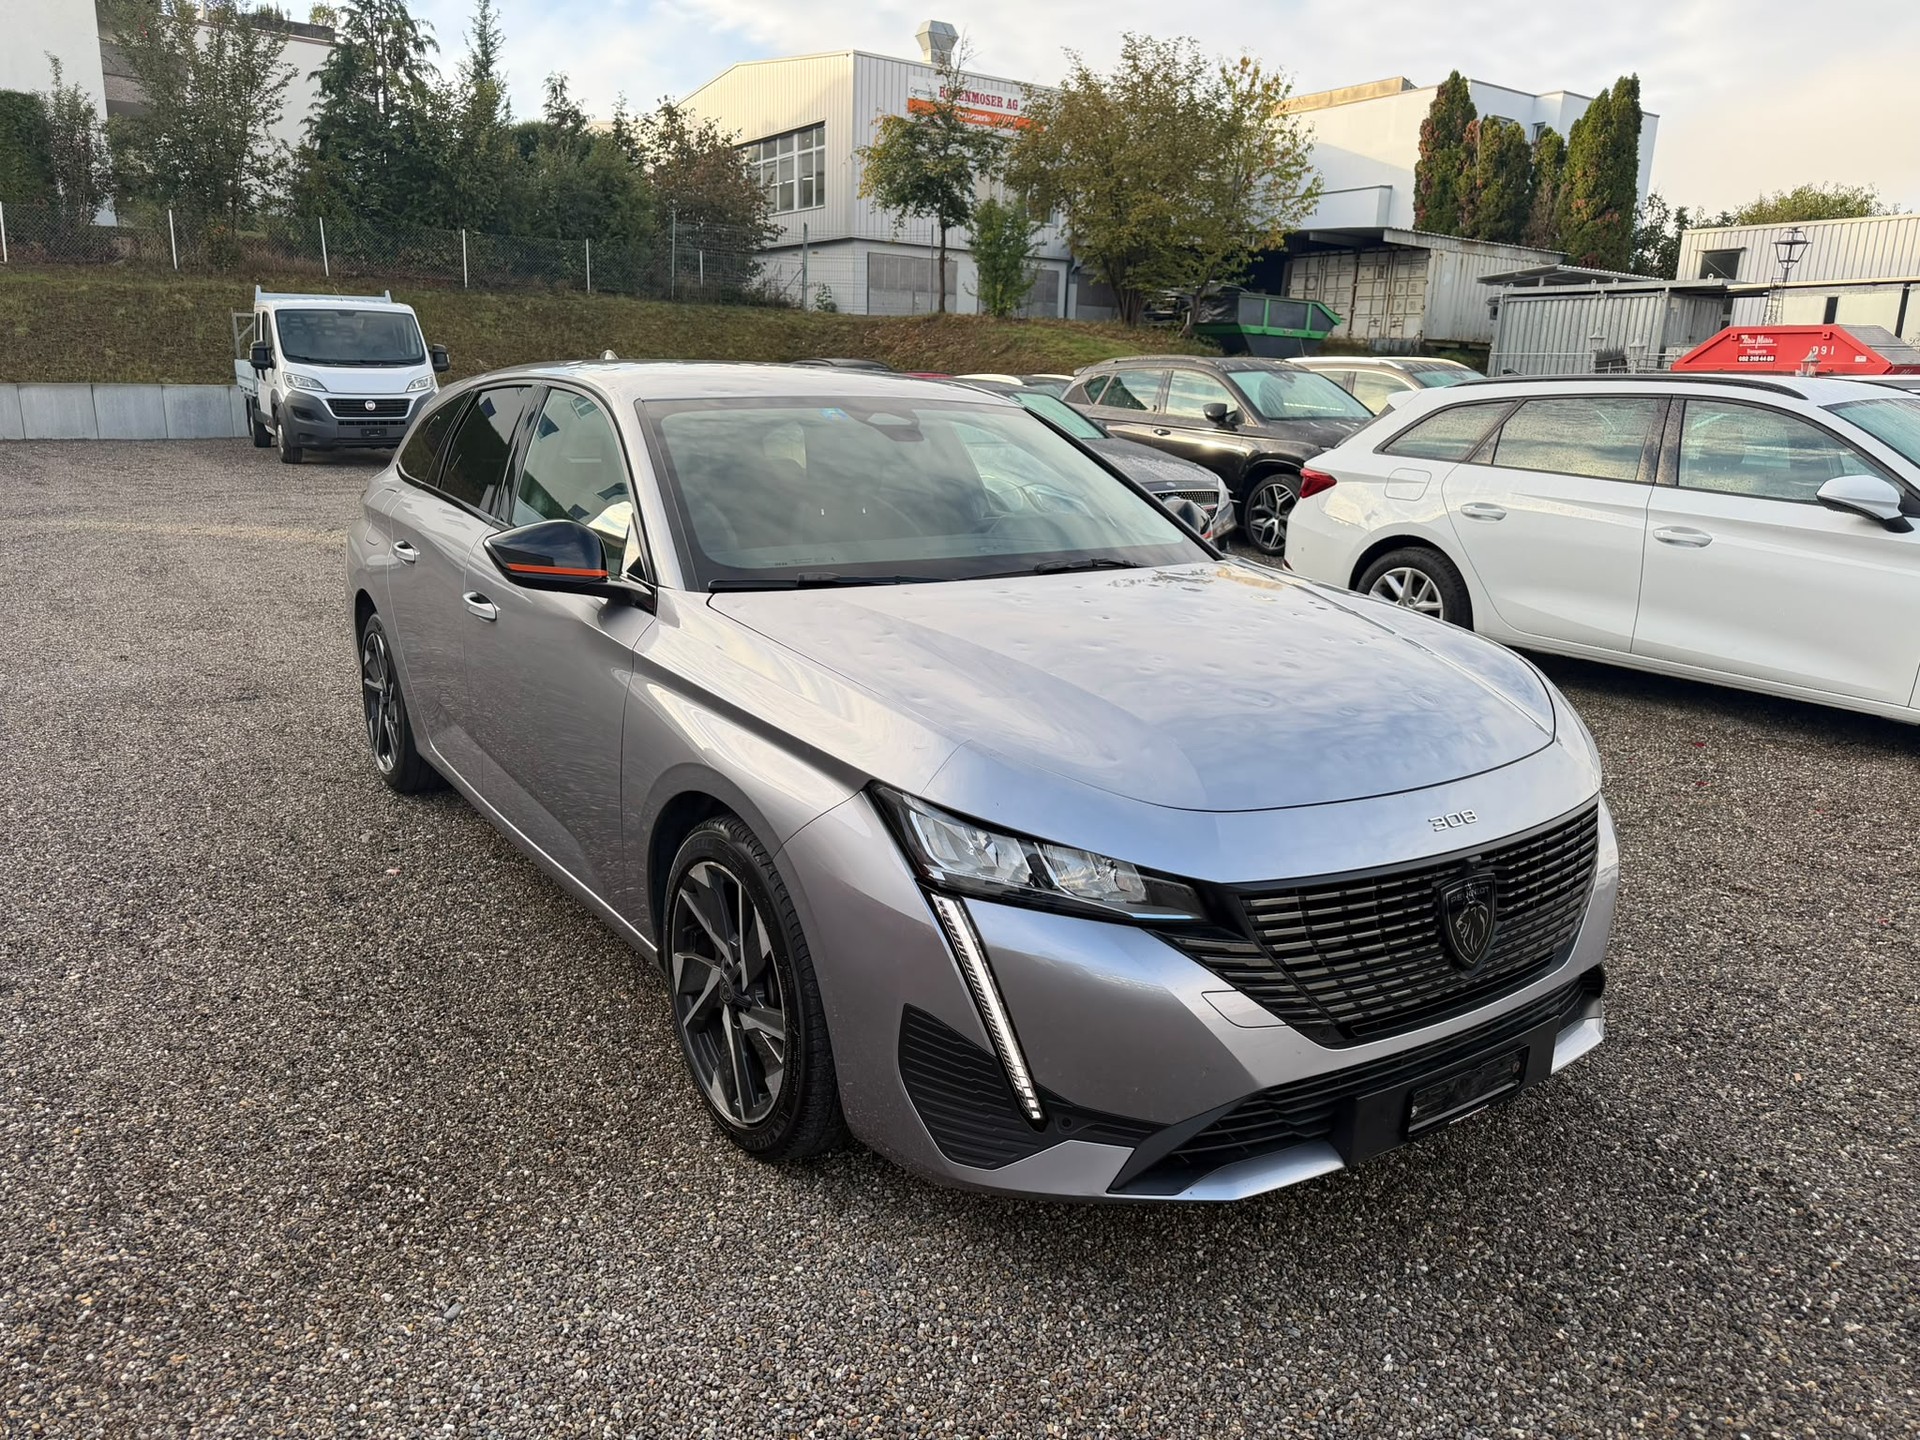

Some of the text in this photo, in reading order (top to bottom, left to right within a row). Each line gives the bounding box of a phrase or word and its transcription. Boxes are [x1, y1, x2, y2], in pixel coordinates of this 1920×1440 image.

[939, 86, 1003, 108] ROENMOSER
[1006, 98, 1018, 110] AG
[1428, 809, 1478, 832] 308
